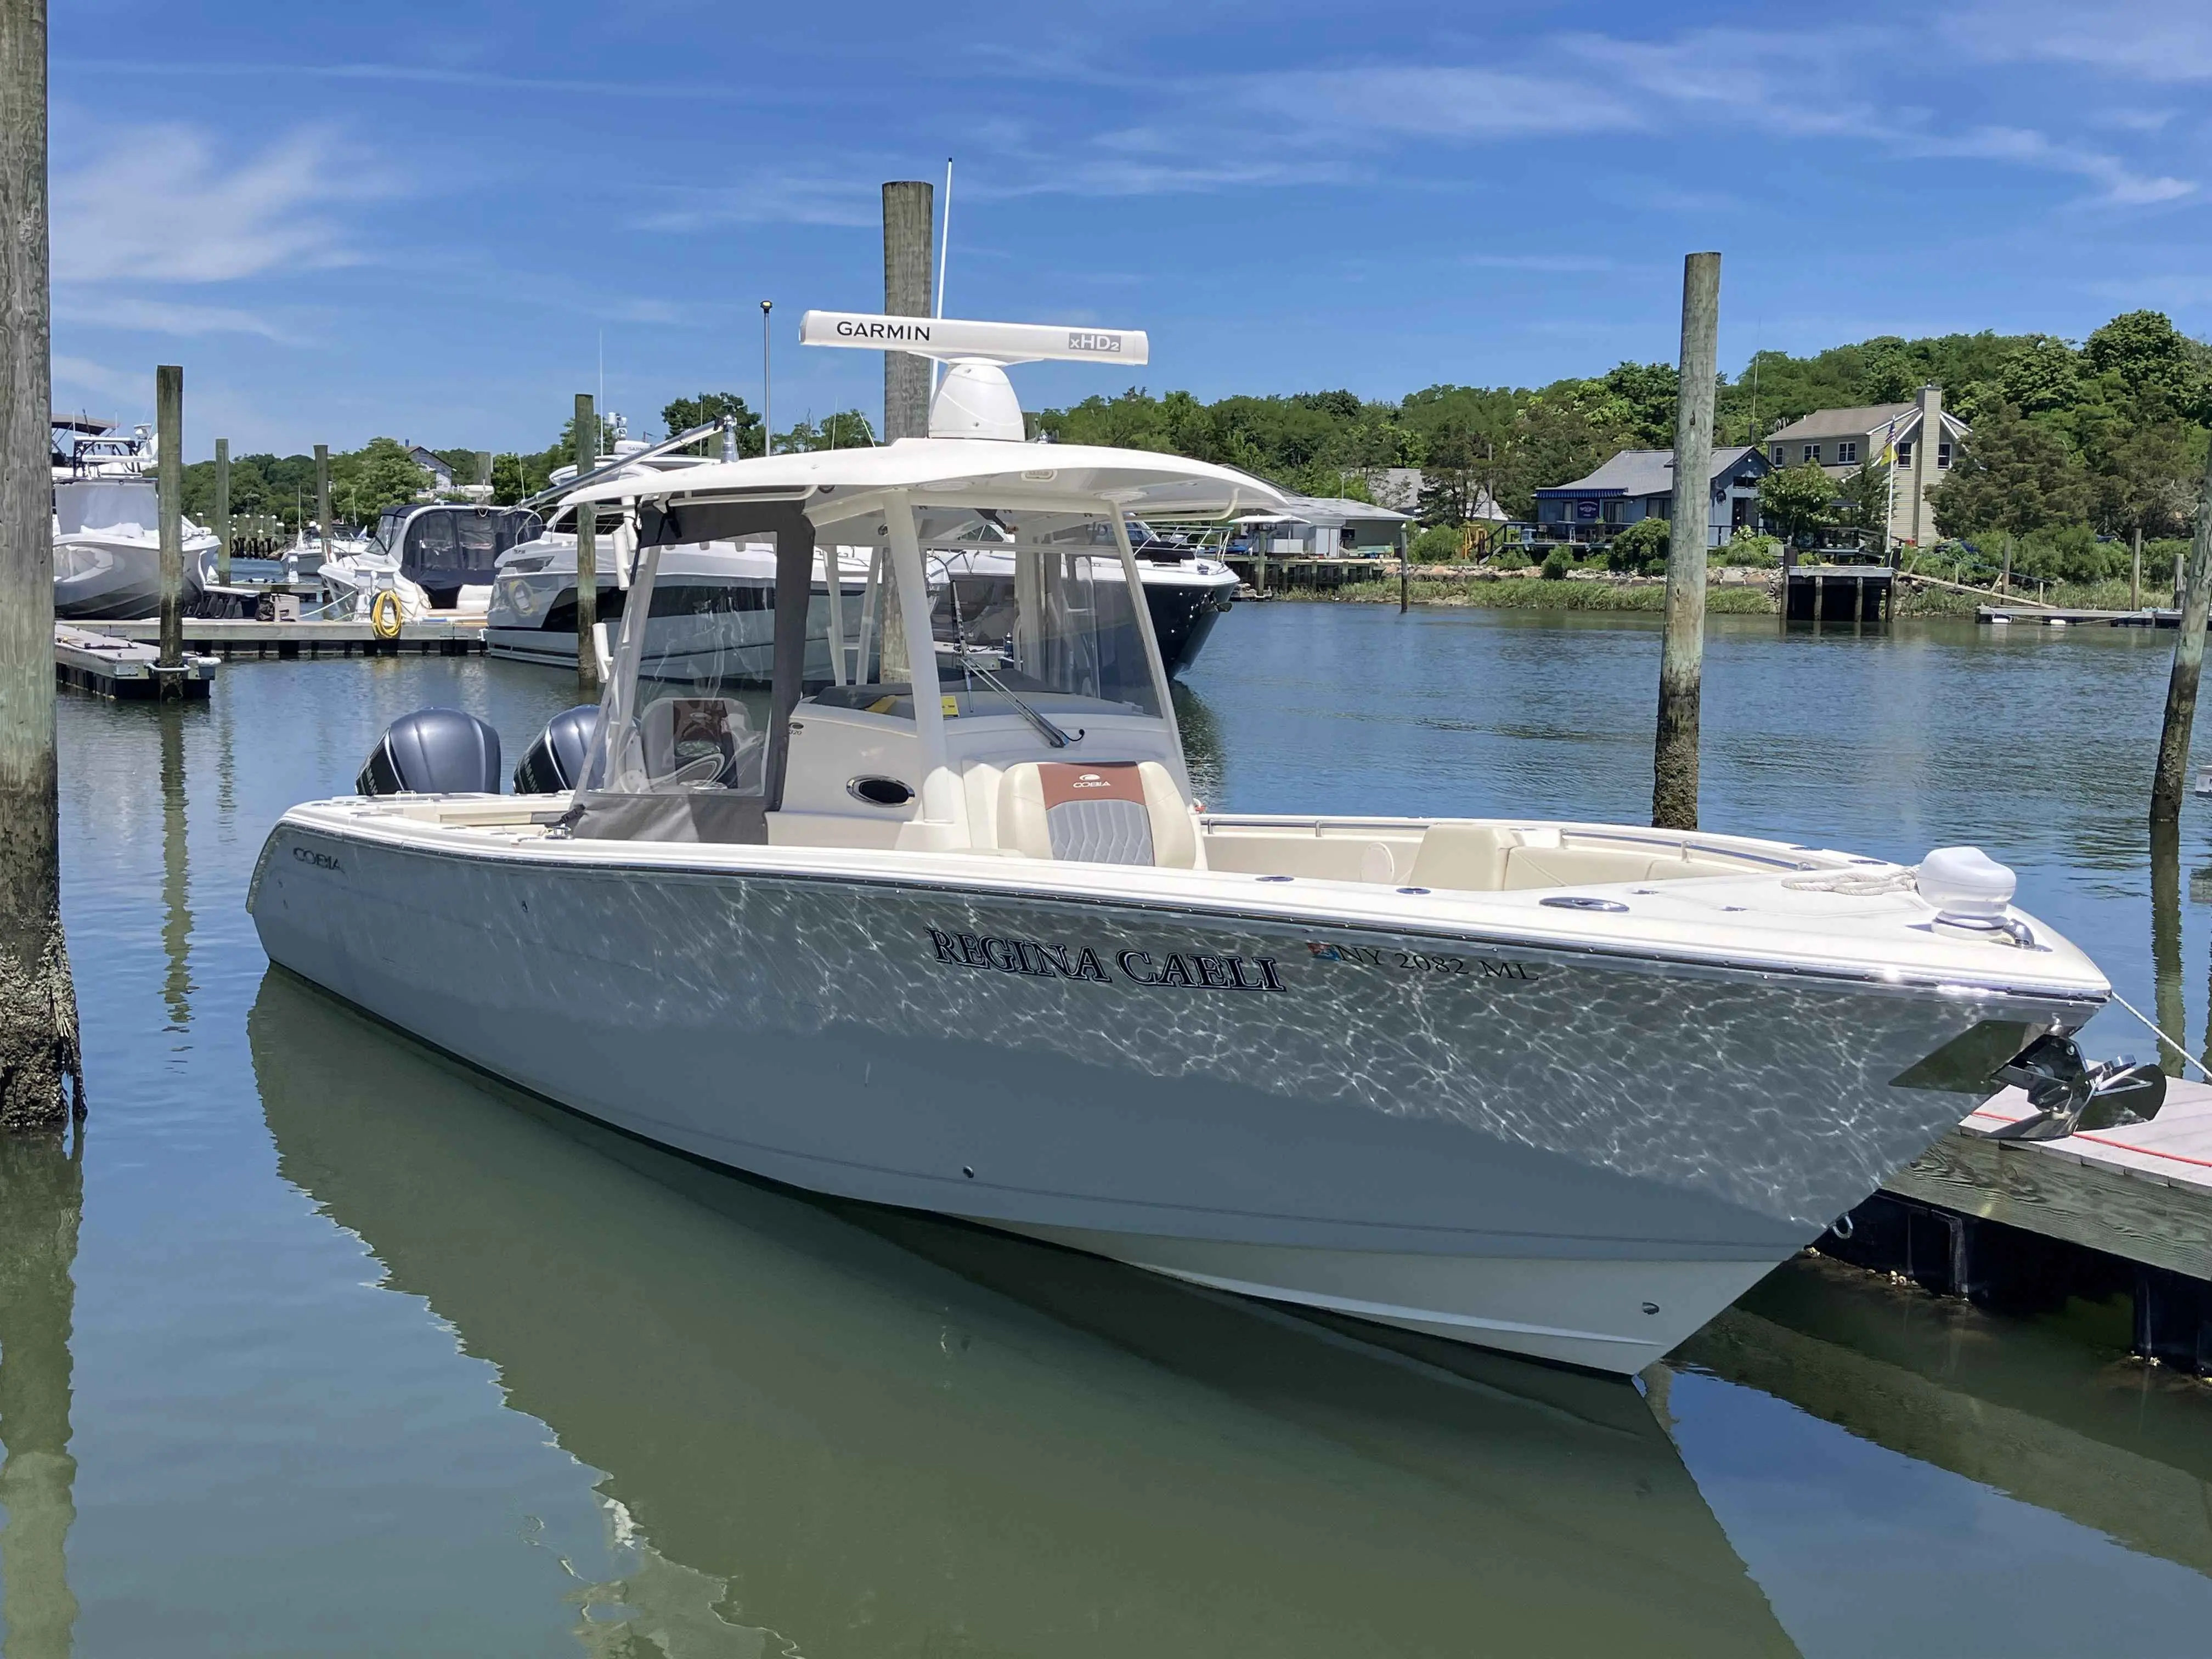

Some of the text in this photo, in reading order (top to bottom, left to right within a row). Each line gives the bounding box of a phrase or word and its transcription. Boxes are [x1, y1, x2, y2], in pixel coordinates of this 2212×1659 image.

[837, 321, 1120, 351] GARMIN xHD2
[293, 847, 346, 874] COBIA
[923, 927, 1287, 992] REGINA CAELI
[1331, 944, 1383, 966] NY
[1395, 952, 1470, 975] 2082
[1478, 960, 1539, 981] ML
